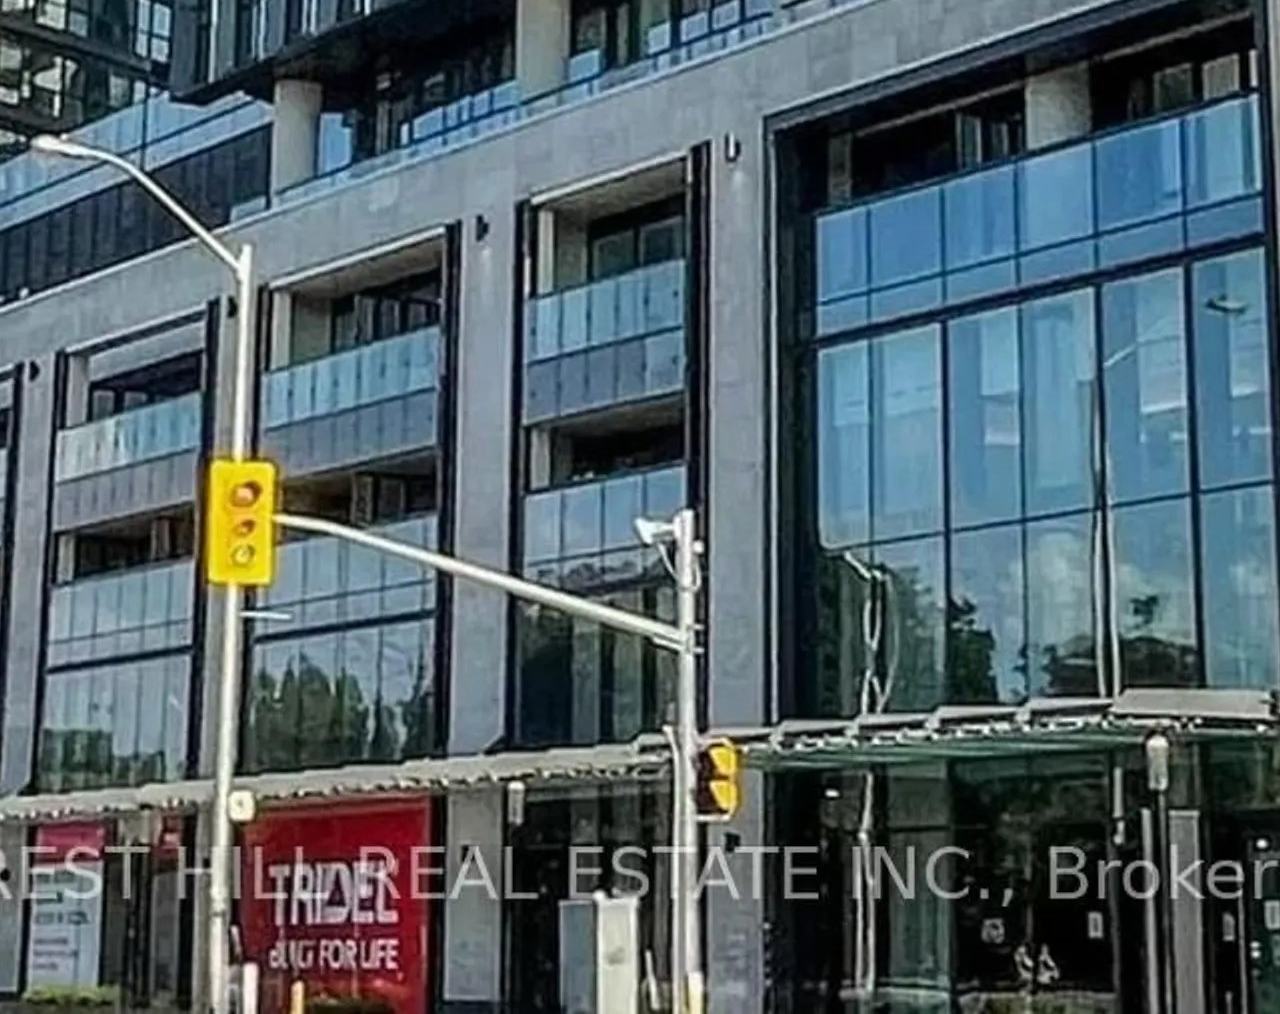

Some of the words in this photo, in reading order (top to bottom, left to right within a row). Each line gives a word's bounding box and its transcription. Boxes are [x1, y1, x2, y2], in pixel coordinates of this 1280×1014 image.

[269, 861, 399, 926] TRIDEL
[319, 938, 359, 971] FOR
[360, 938, 400, 970] LIFE
